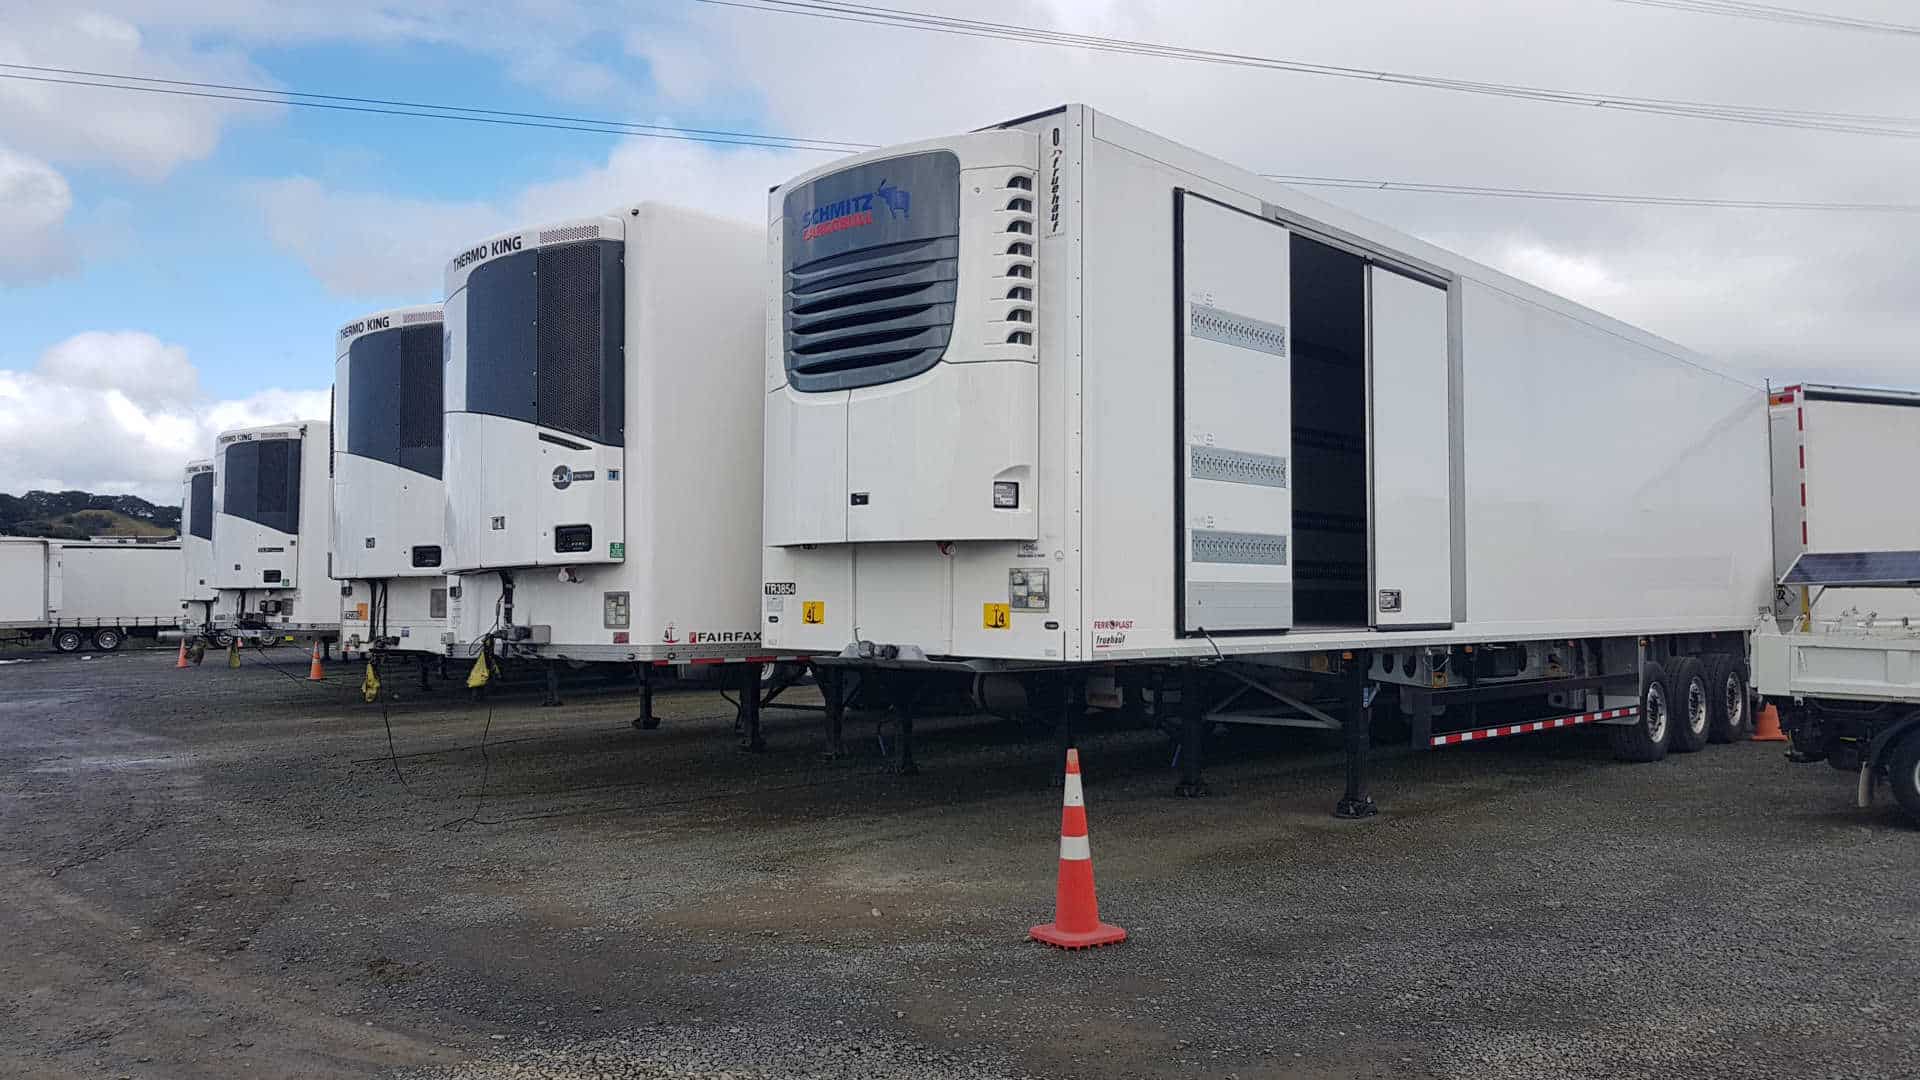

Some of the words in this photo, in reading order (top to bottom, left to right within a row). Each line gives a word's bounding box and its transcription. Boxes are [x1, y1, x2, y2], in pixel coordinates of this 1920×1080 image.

[802, 192, 873, 229] SCHMITZ
[453, 246, 487, 272] THERMO
[491, 236, 522, 257] KING
[367, 316, 390, 331] KING
[765, 583, 797, 596] TR3854
[698, 631, 762, 642] FAIRFAX
